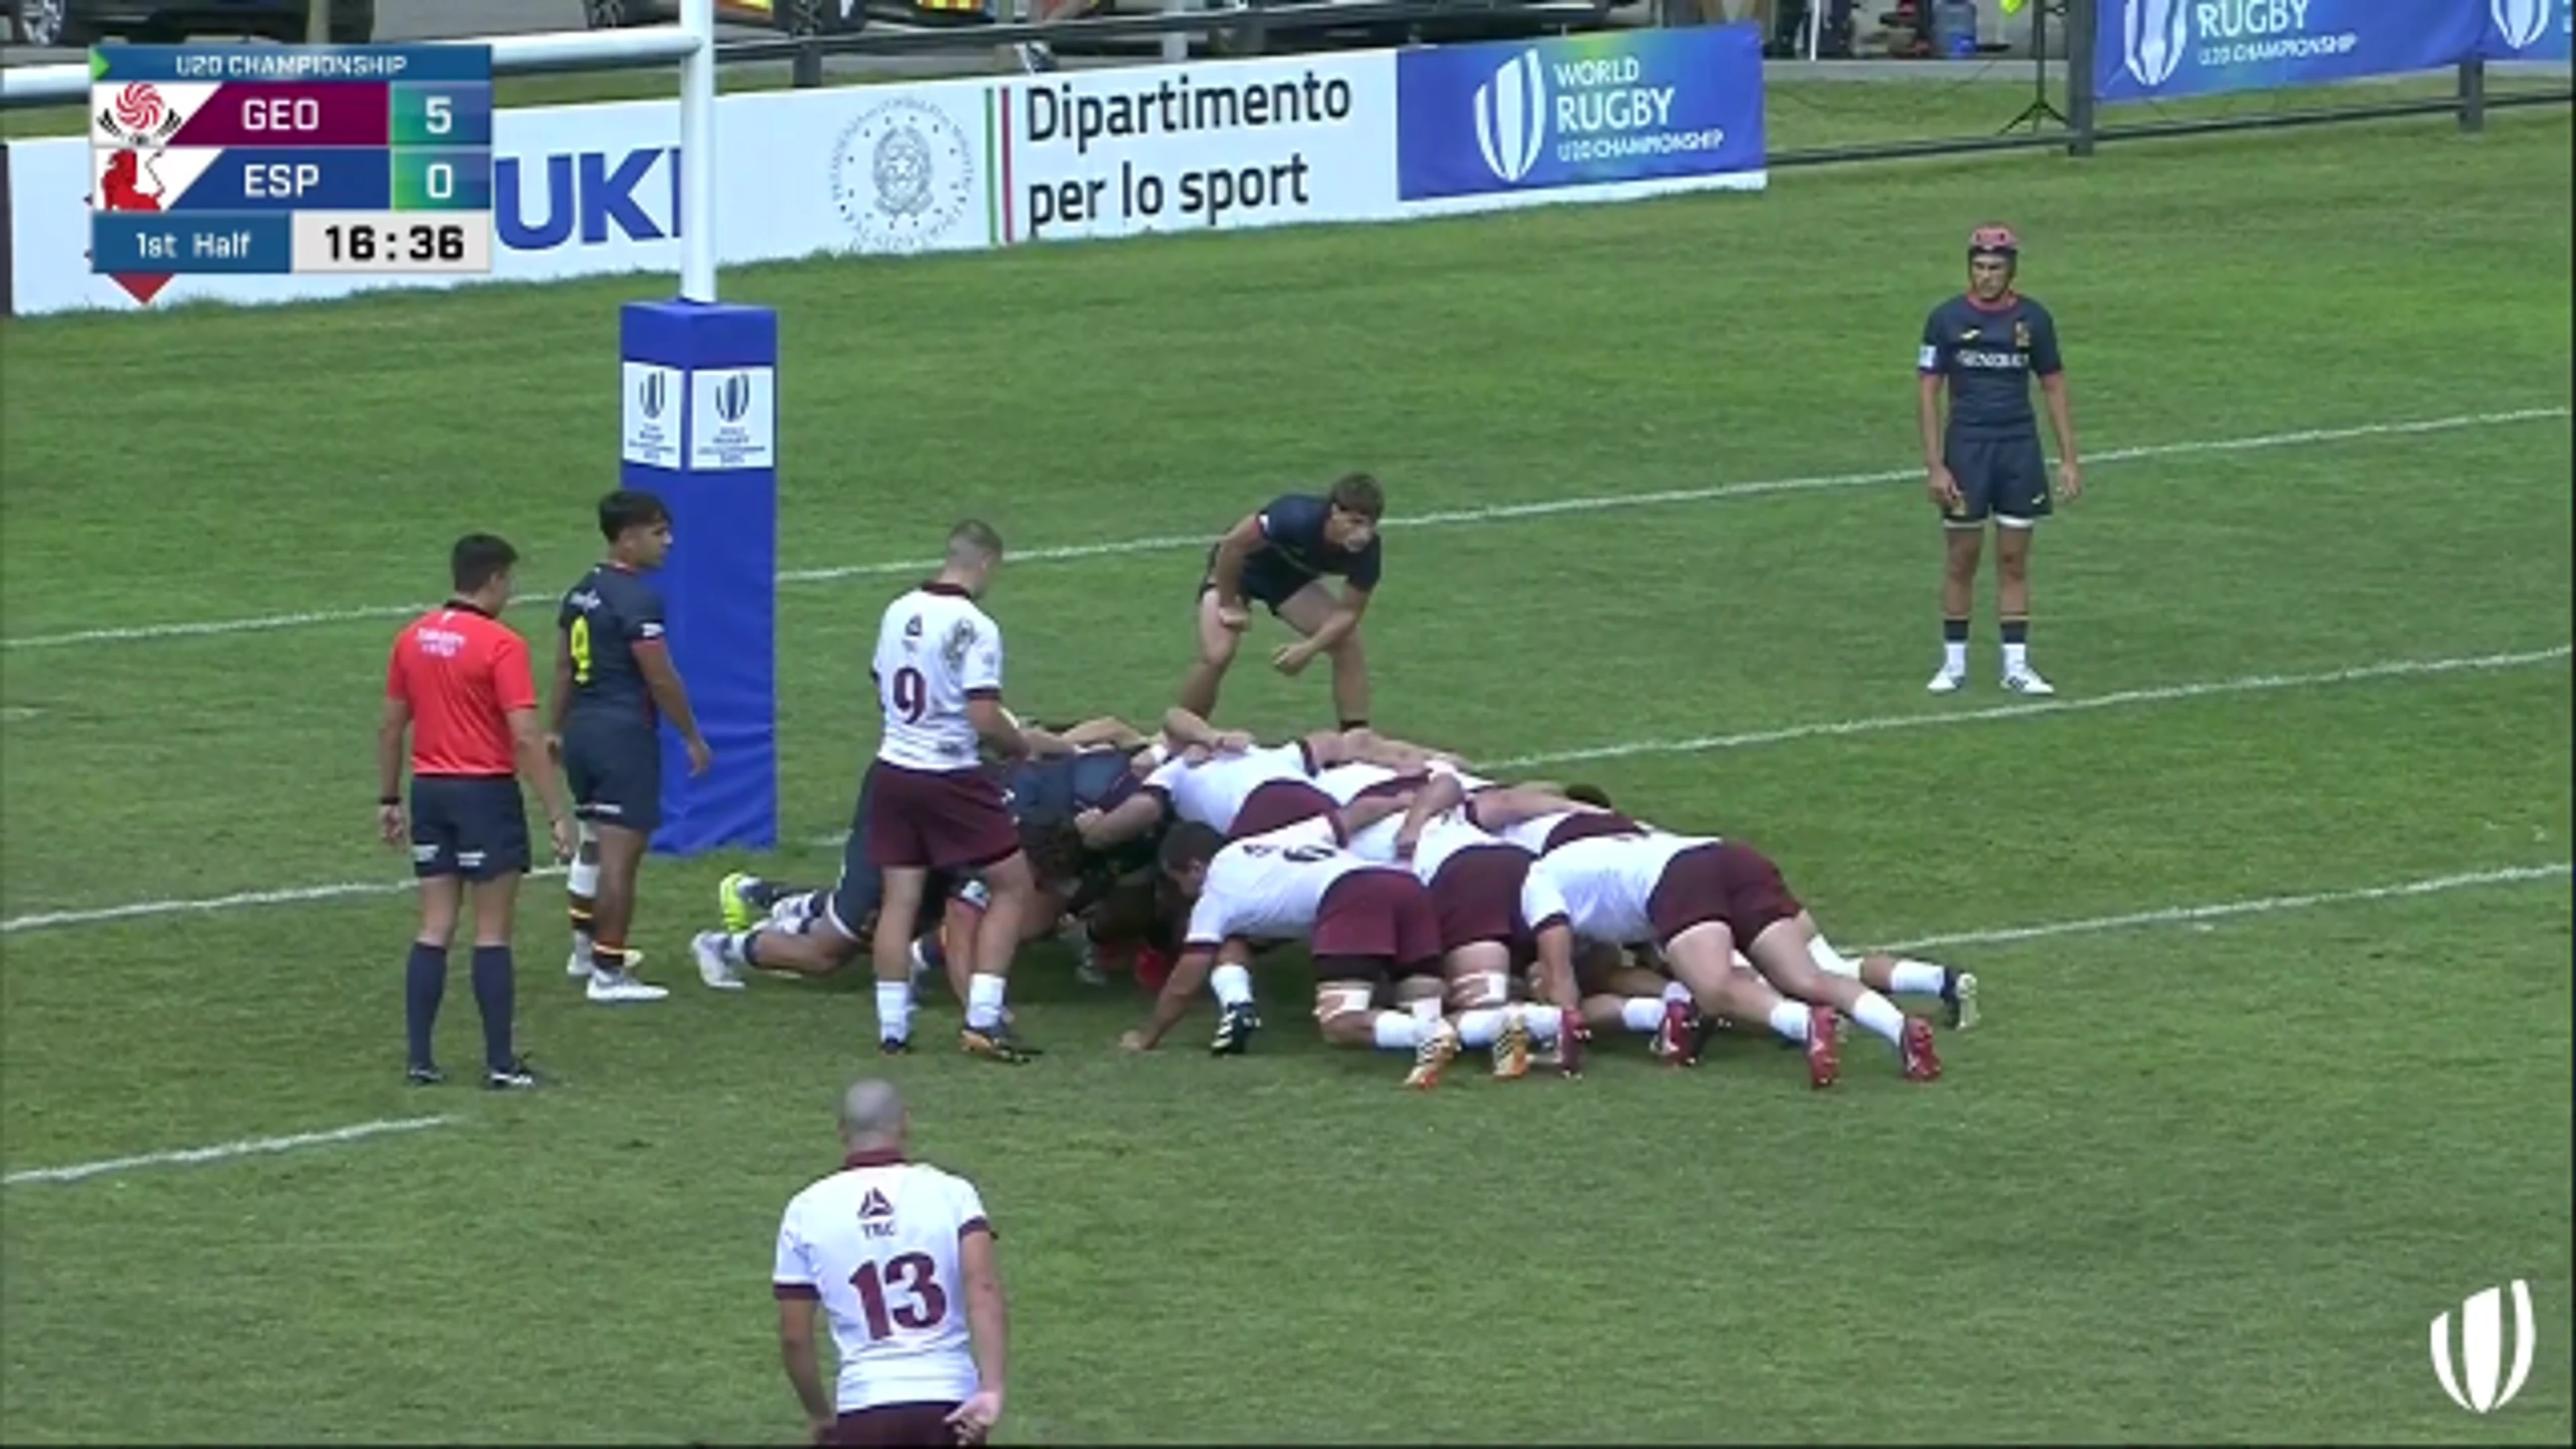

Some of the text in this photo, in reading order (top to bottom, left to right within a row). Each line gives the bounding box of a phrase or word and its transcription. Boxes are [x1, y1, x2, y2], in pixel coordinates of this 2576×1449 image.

[1554, 57, 1640, 87] WORLD
[1026, 70, 1350, 154] Dipartimento
[1556, 87, 1676, 133] RUGBY
[1592, 127, 1724, 159] CHAMPIONSHIP
[1028, 152, 1309, 242] per lo sport
[894, 667, 926, 724] 9
[848, 1252, 947, 1341] 13
